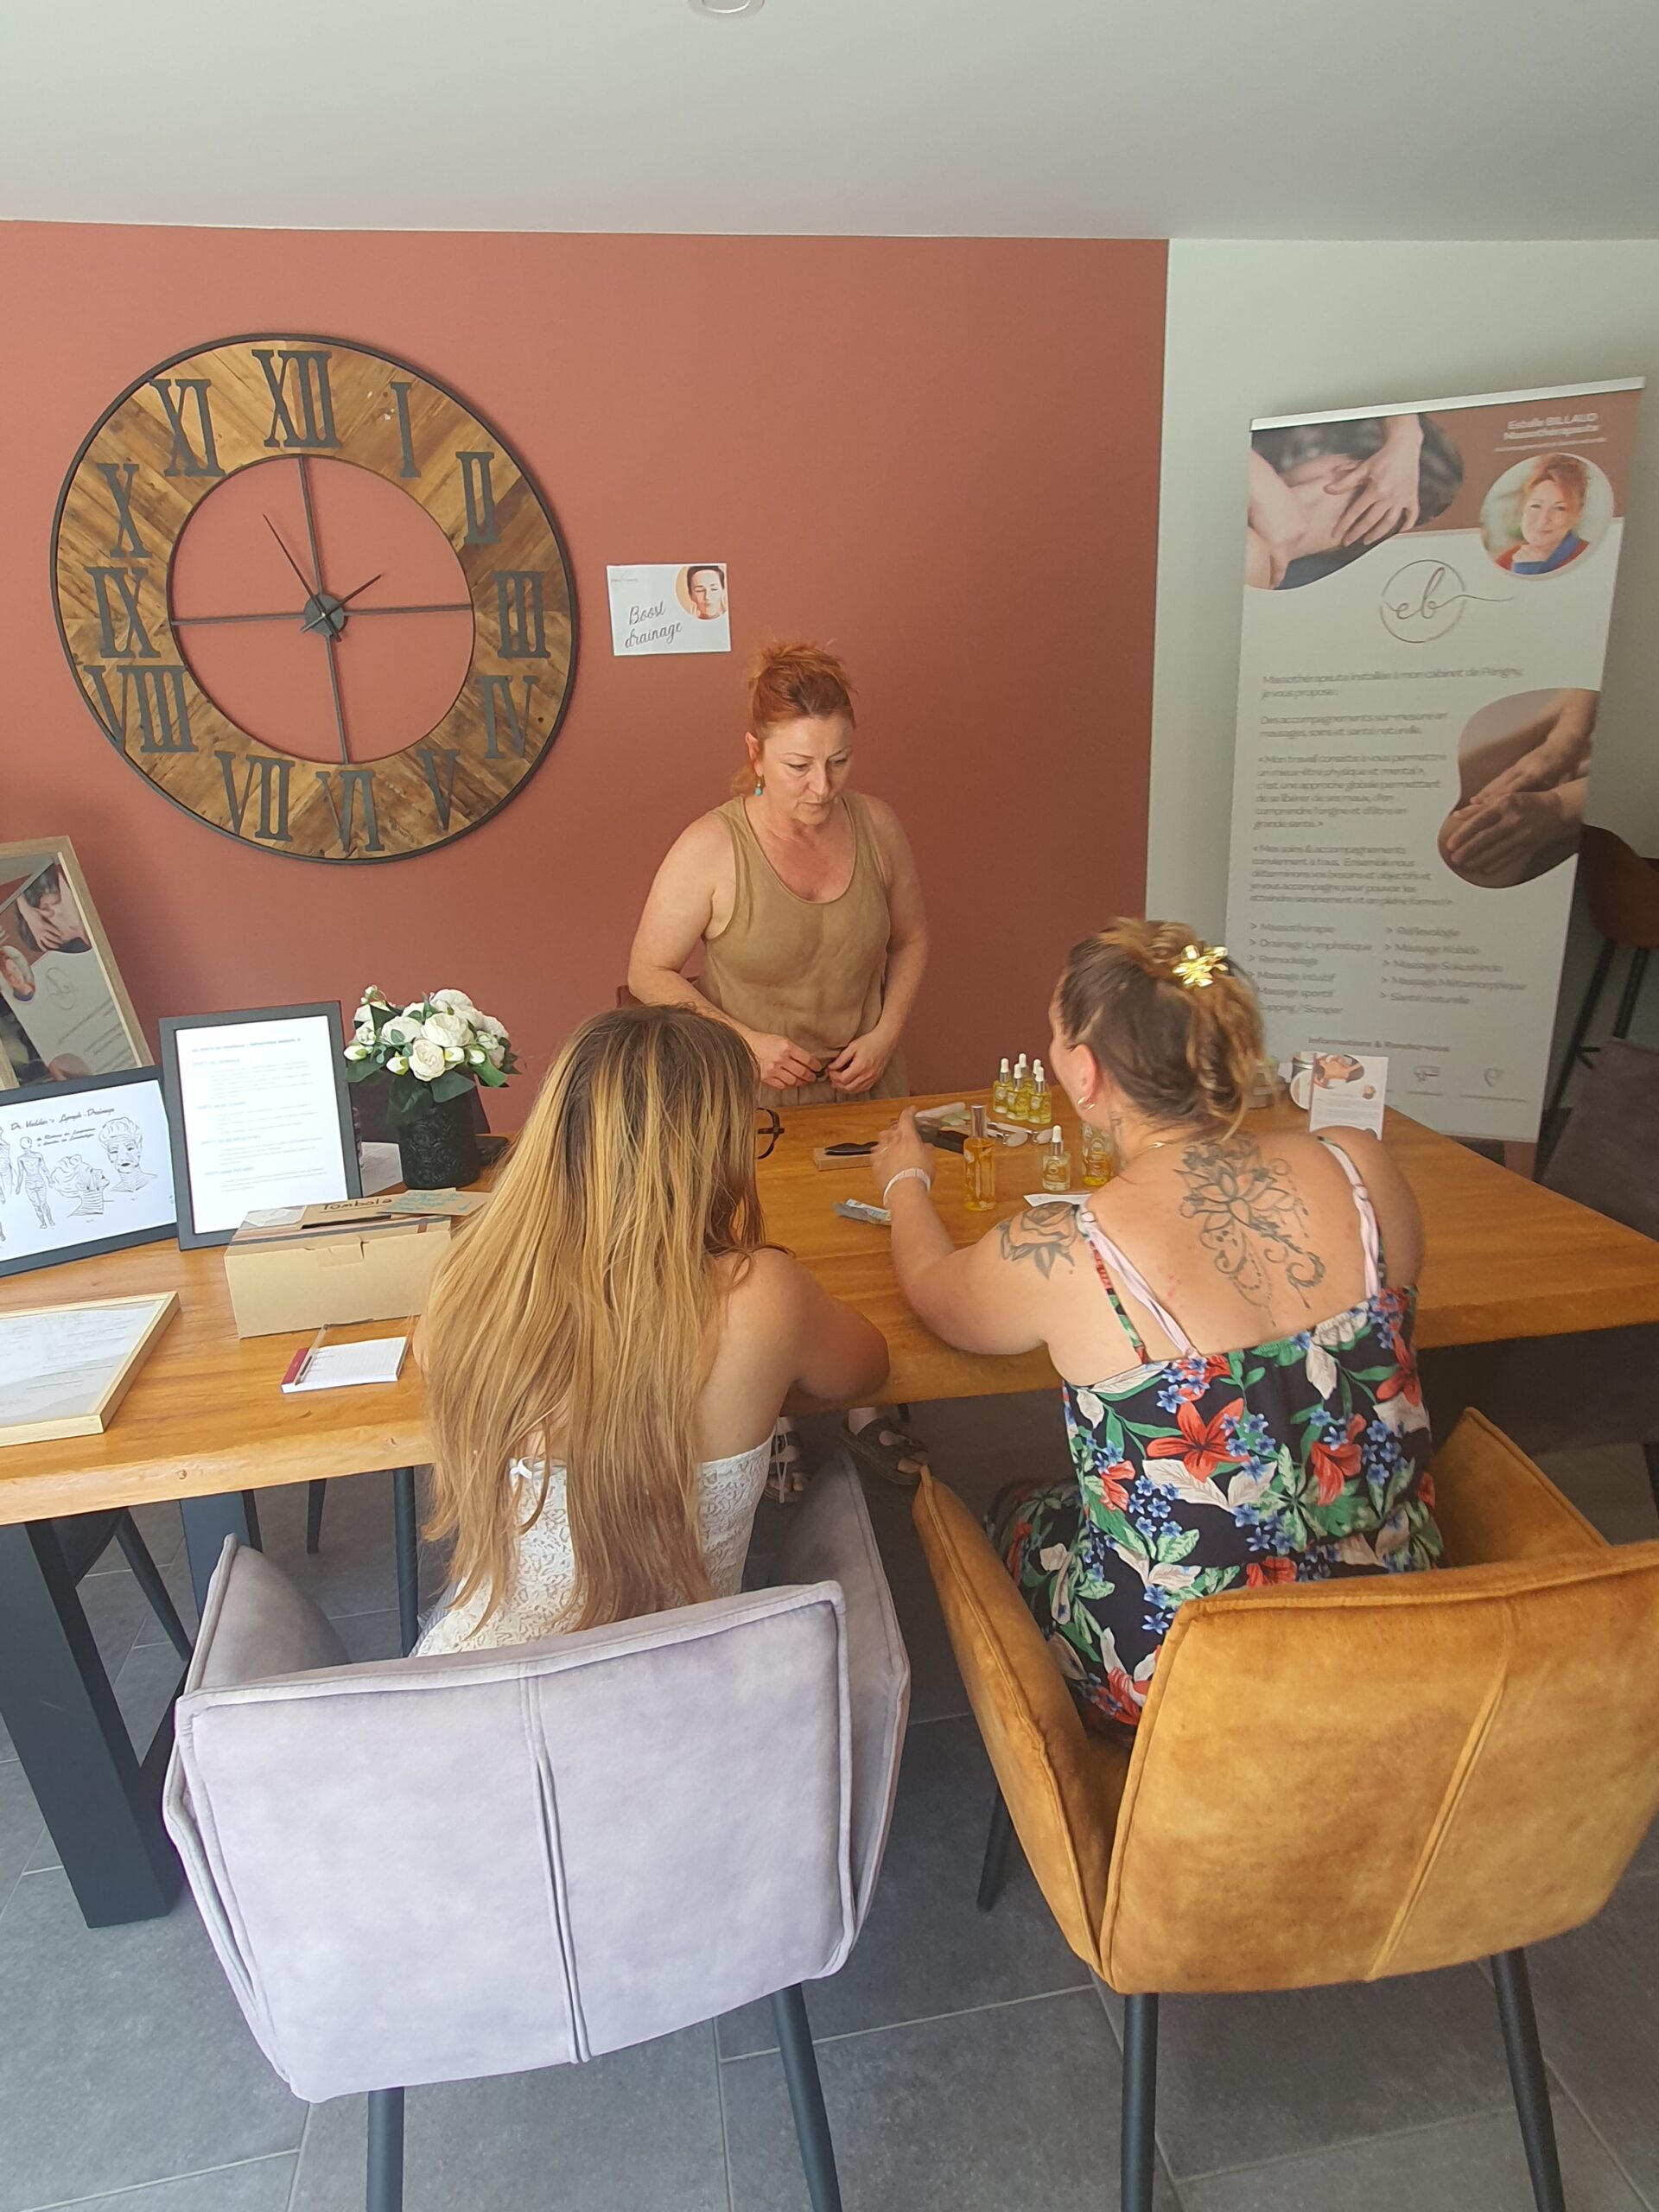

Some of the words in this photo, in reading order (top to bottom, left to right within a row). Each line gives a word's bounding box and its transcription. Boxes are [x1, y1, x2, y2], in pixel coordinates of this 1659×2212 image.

[149, 378, 226, 477] XI
[251, 349, 342, 448] XII
[390, 381, 421, 478] I
[97, 463, 151, 557] X
[455, 451, 501, 543] II
[85, 567, 161, 658] IX
[493, 570, 551, 658] III
[624, 622, 683, 648] drainage
[628, 601, 666, 626] Boost
[83, 665, 199, 753] VIII
[479, 675, 538, 760] IV
[213, 750, 296, 842] VII
[315, 770, 385, 853] VI
[417, 748, 461, 831] V
[323, 1198, 393, 1211] Tombola
